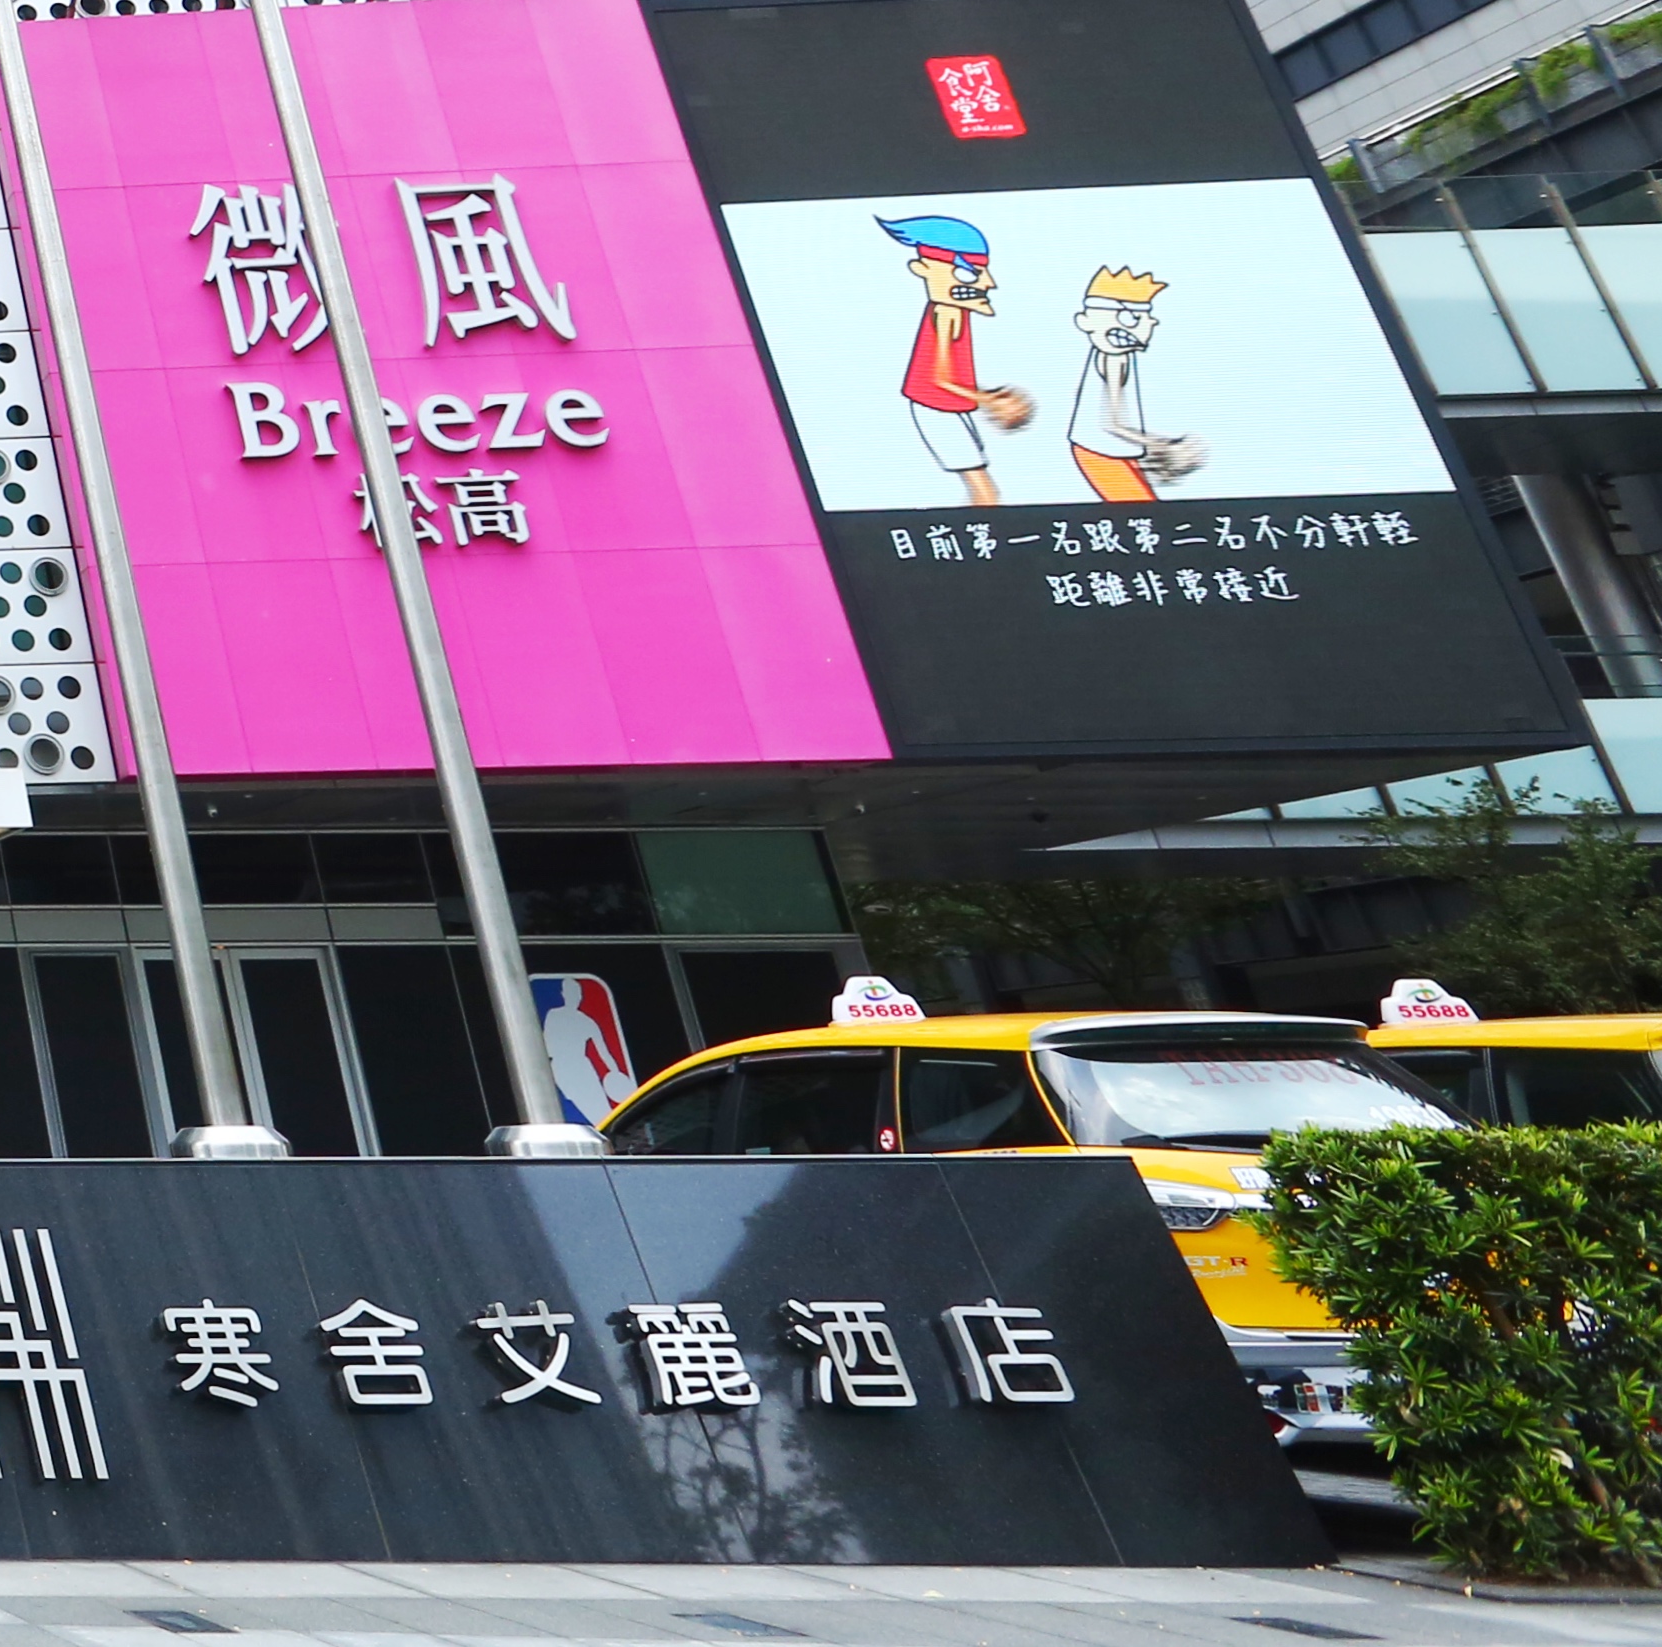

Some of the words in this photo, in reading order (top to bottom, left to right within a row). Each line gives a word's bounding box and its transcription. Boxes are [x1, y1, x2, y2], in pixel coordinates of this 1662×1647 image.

[189, 173, 577, 355] 微風
[226, 381, 609, 459] Breeze
[354, 468, 530, 547] 松高
[1046, 566, 1300, 607] 距離非常接近
[848, 1003, 917, 1018] 55688
[1398, 1004, 1470, 1018] 55688
[165, 1297, 1075, 1408] 寒舍艾麗酒店
